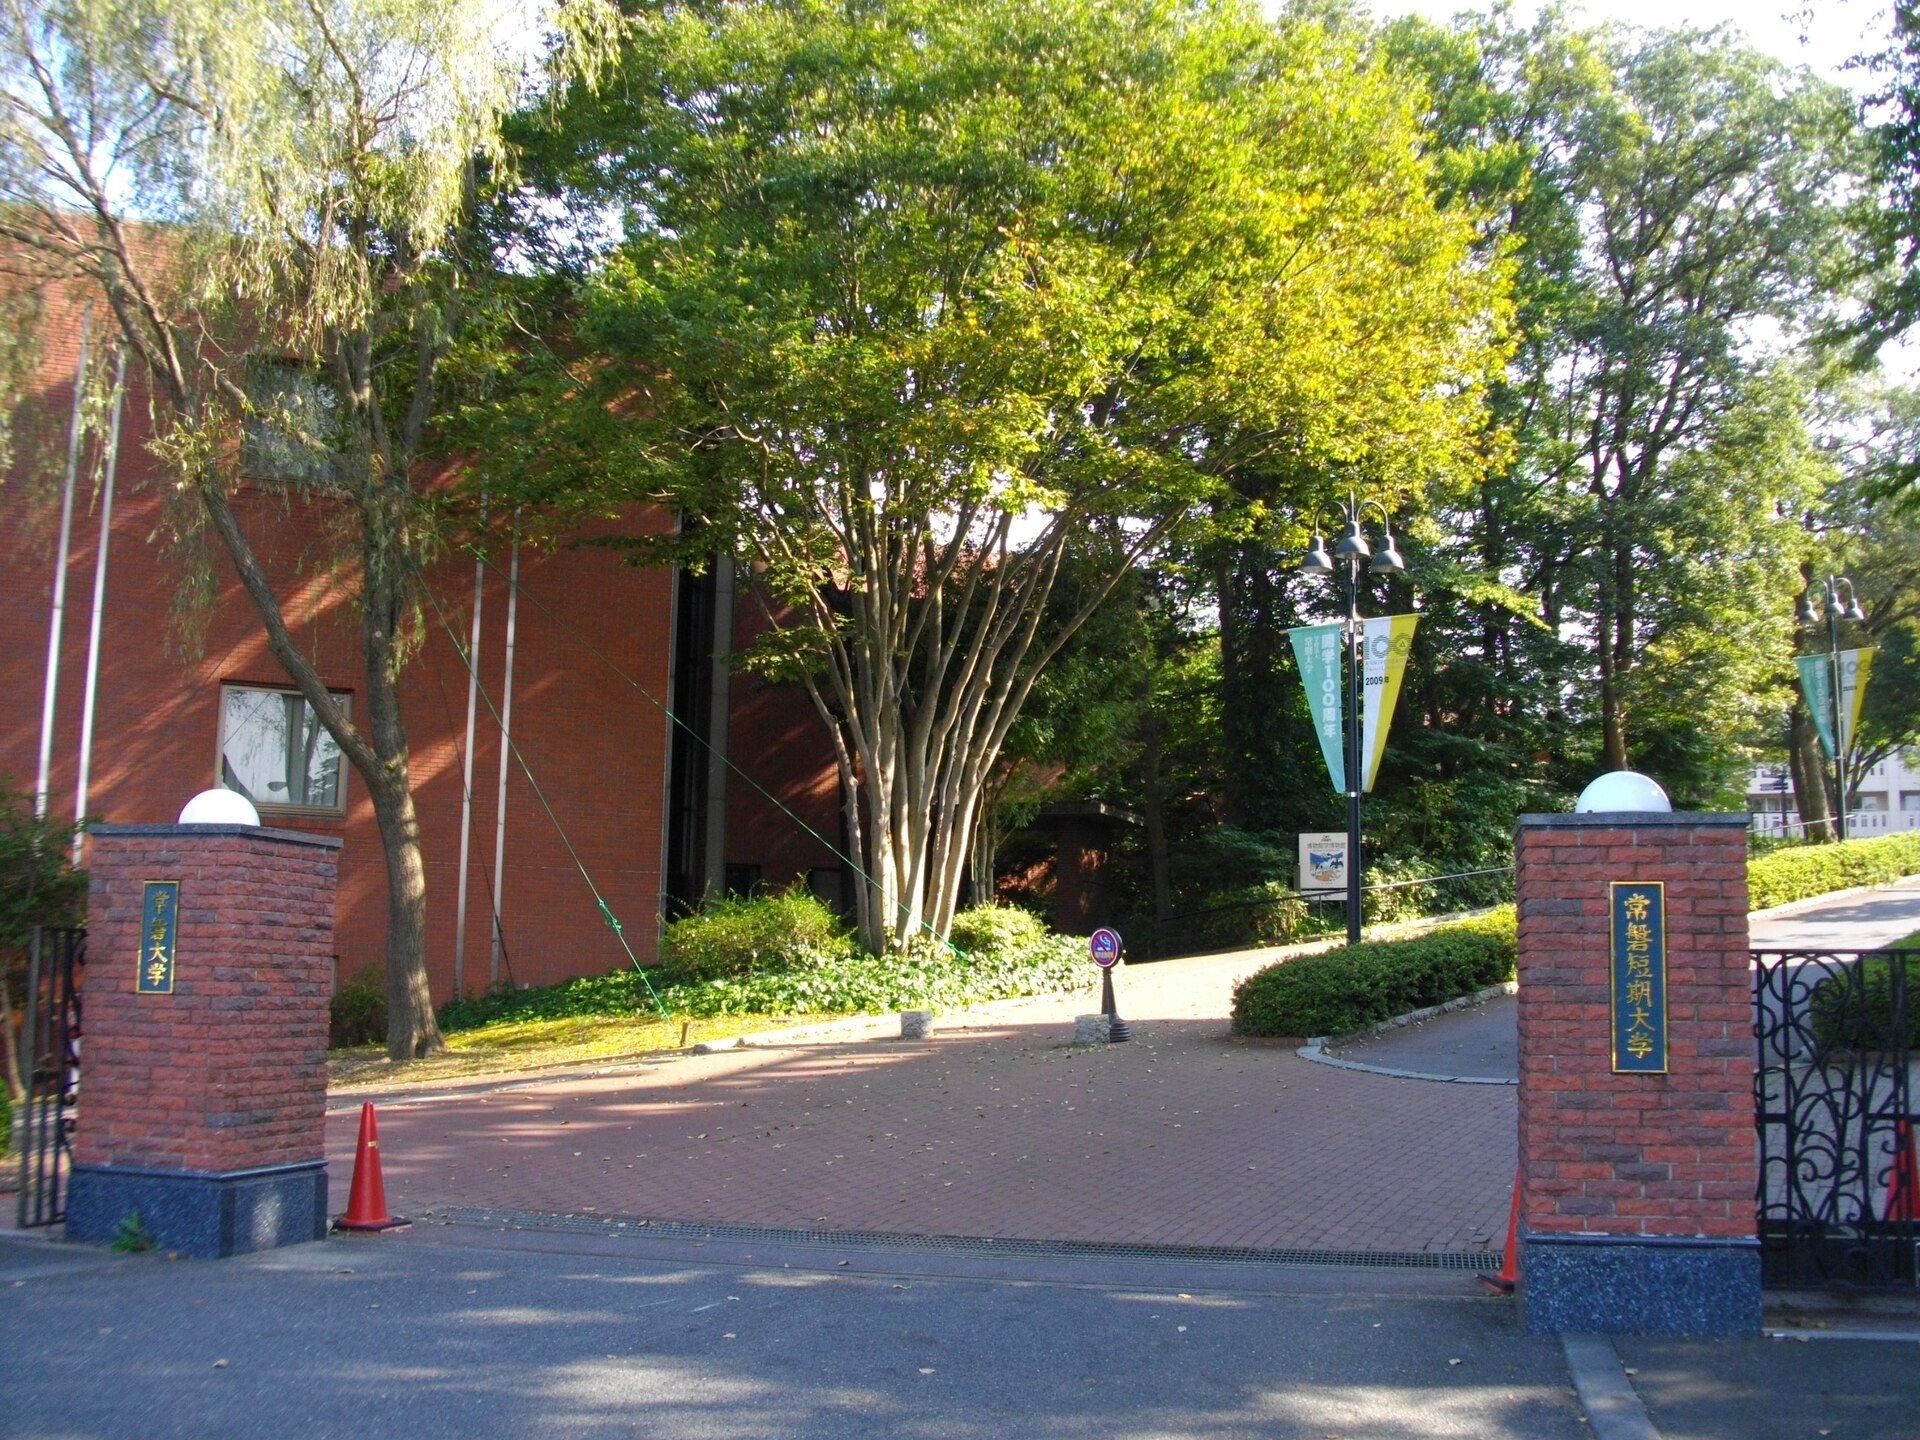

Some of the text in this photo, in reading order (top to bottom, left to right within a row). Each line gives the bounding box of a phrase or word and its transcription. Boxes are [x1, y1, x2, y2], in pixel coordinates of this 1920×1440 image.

[147, 891, 170, 986] 常磐大学
[1624, 893, 1655, 1059] 常磐短期大学
